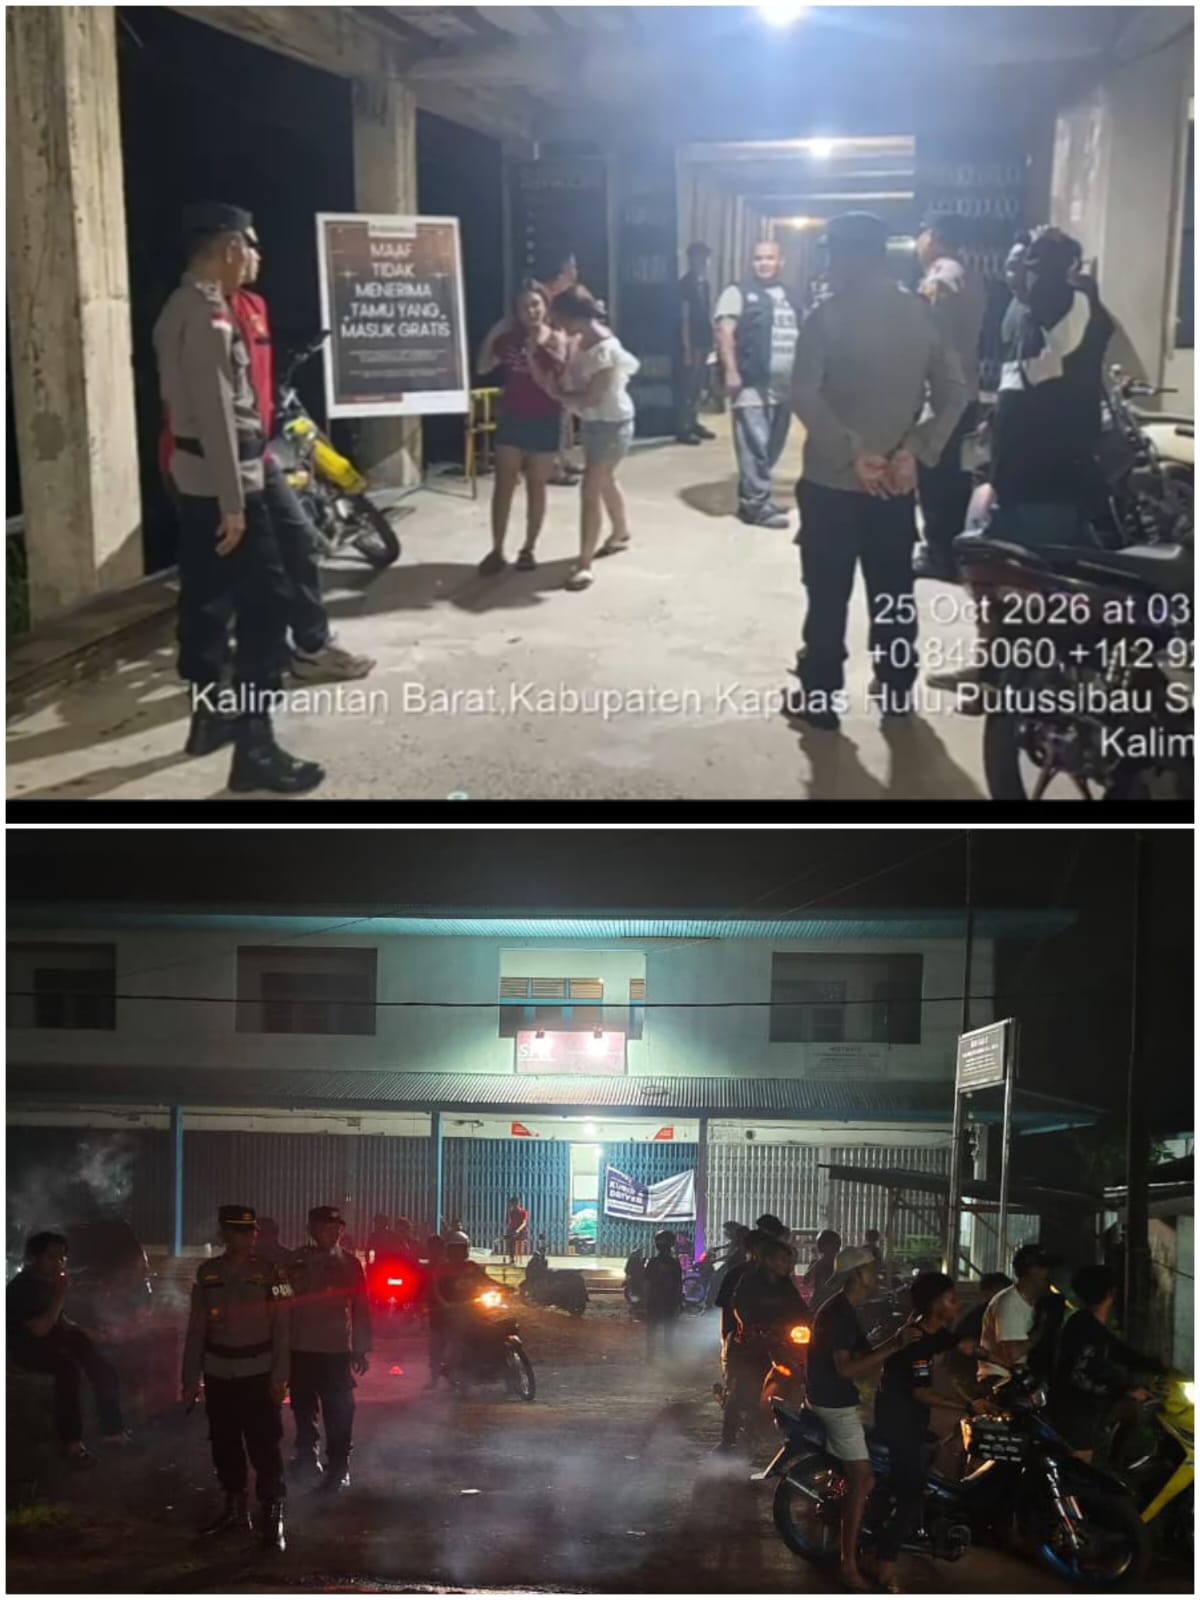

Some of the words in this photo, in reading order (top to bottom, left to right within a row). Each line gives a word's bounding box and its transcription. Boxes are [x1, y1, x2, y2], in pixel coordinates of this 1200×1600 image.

[370, 243, 414, 258] MAAF
[372, 263, 415, 278] TIDAK
[355, 282, 432, 298] MENERIMA
[351, 302, 395, 318] TAMU
[397, 303, 439, 318] YANG
[341, 323, 395, 338] MASUK
[398, 322, 450, 338] GRATIS
